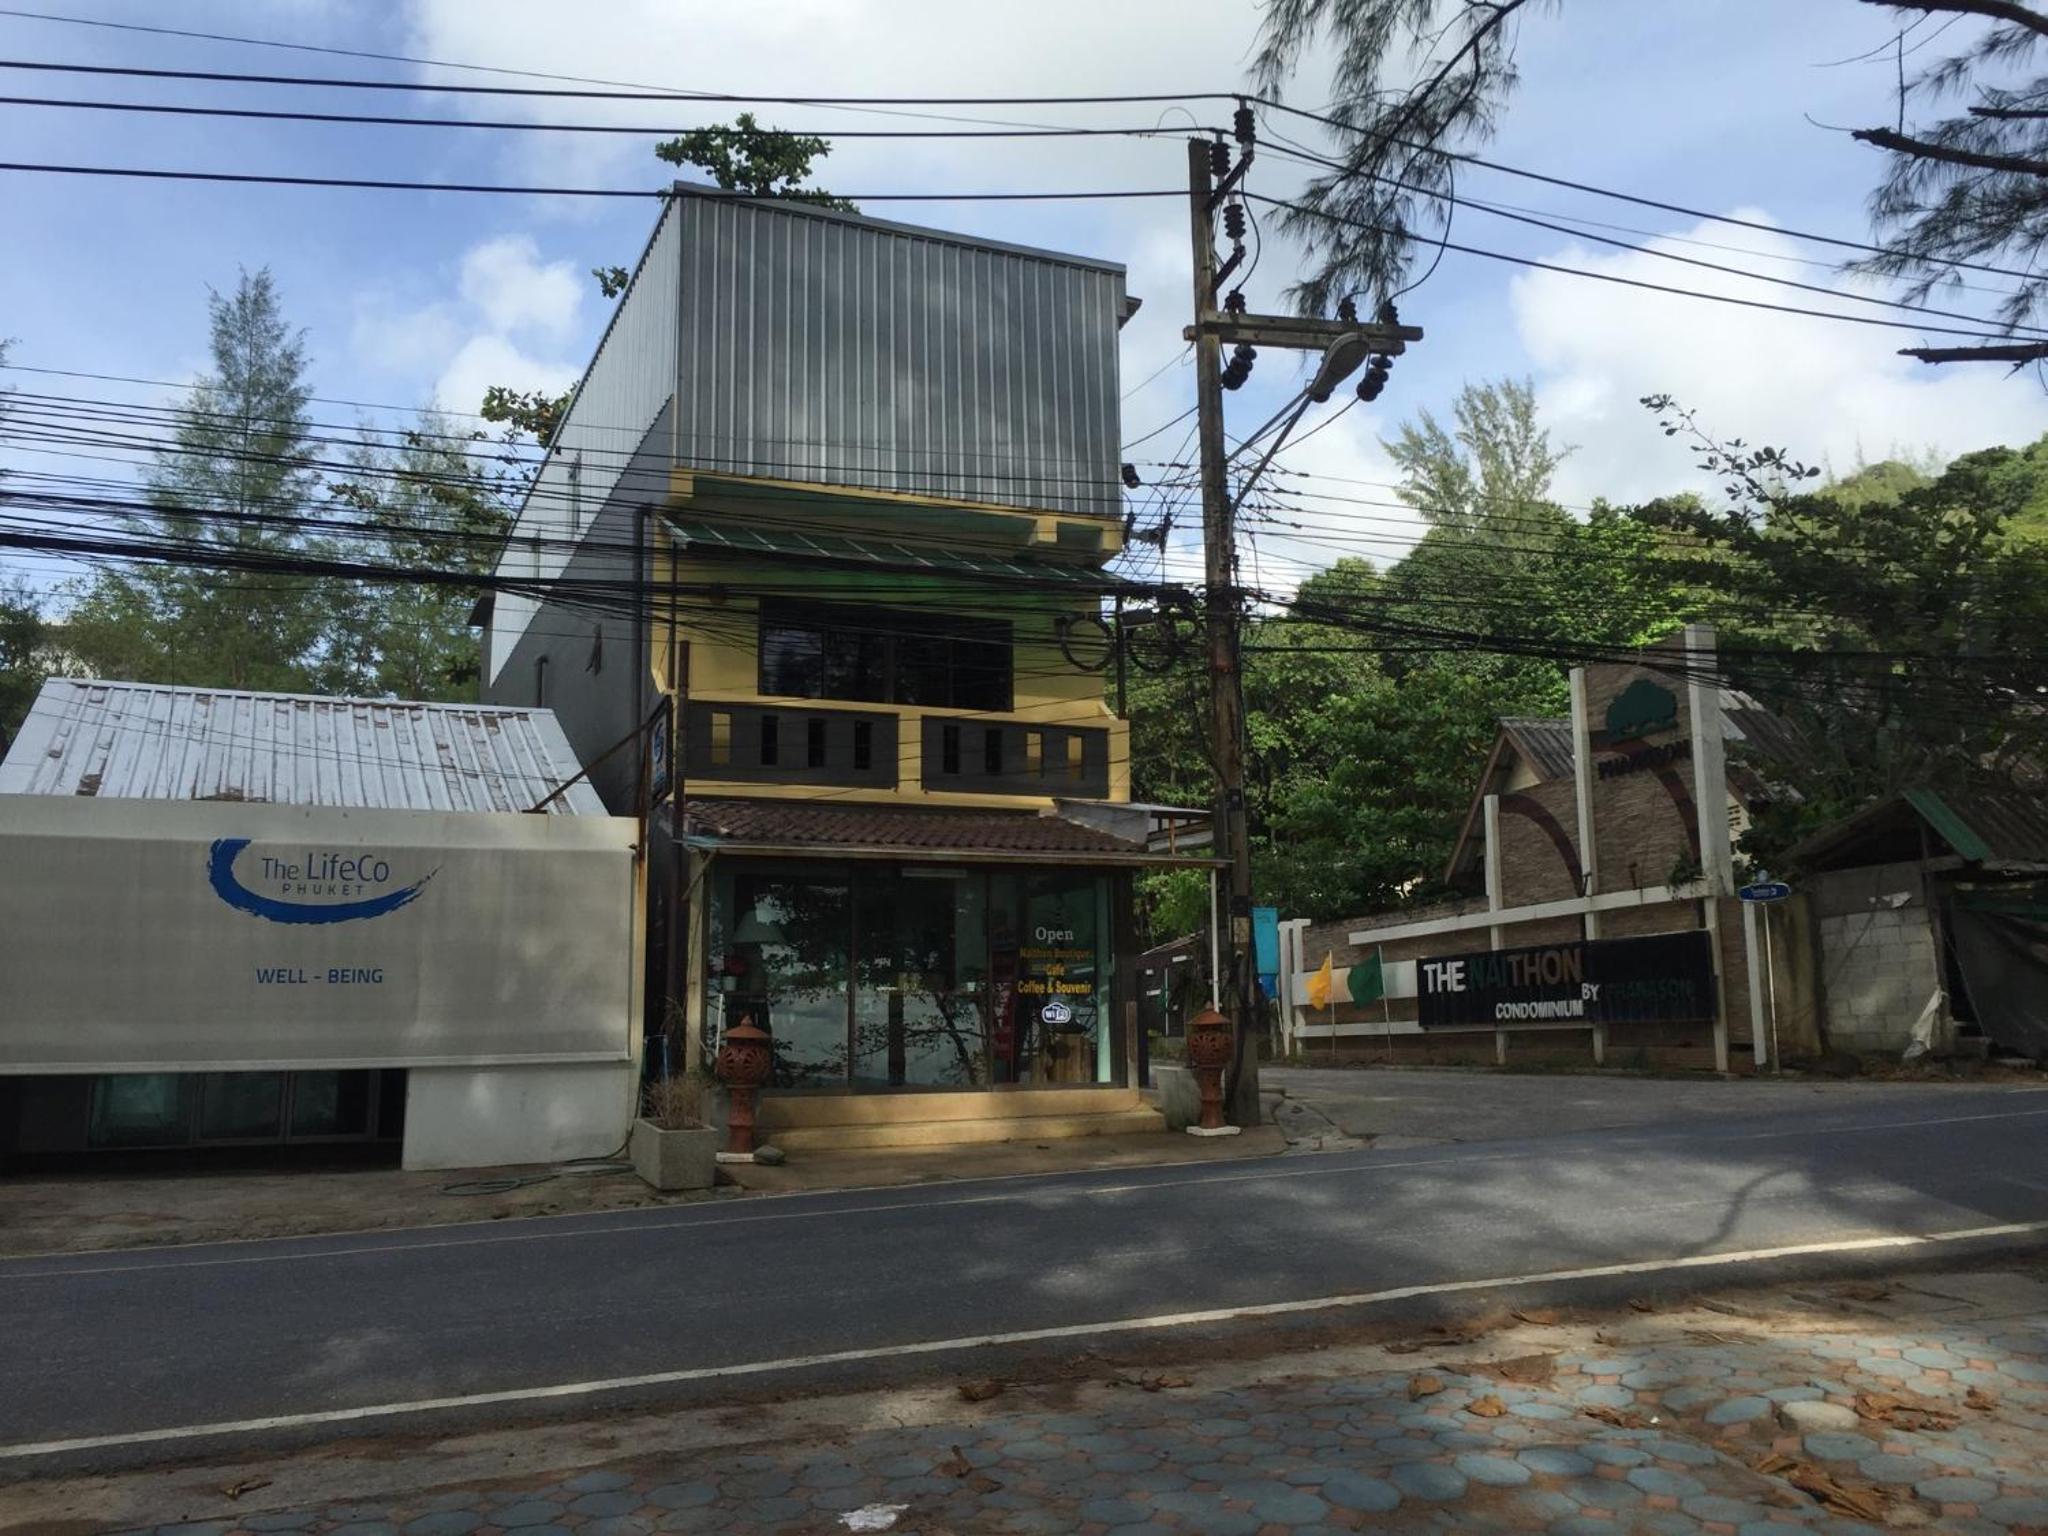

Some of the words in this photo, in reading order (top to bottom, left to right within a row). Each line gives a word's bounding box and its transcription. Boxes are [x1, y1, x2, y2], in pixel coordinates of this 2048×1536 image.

[262, 857, 299, 881] The
[306, 852, 390, 883] LifeCo
[282, 883, 364, 896] PHUKET
[1035, 926, 1074, 944] Open
[256, 968, 307, 984] WELL
[327, 968, 384, 984] BEING
[1423, 960, 1465, 994] THE
[1017, 980, 1045, 994] Coffee
[1046, 981, 1054, 994] &
[1055, 980, 1092, 994] Souvenir
[1581, 982, 1600, 1002] BY
[1495, 999, 1584, 1020] CONDOMINIUM
